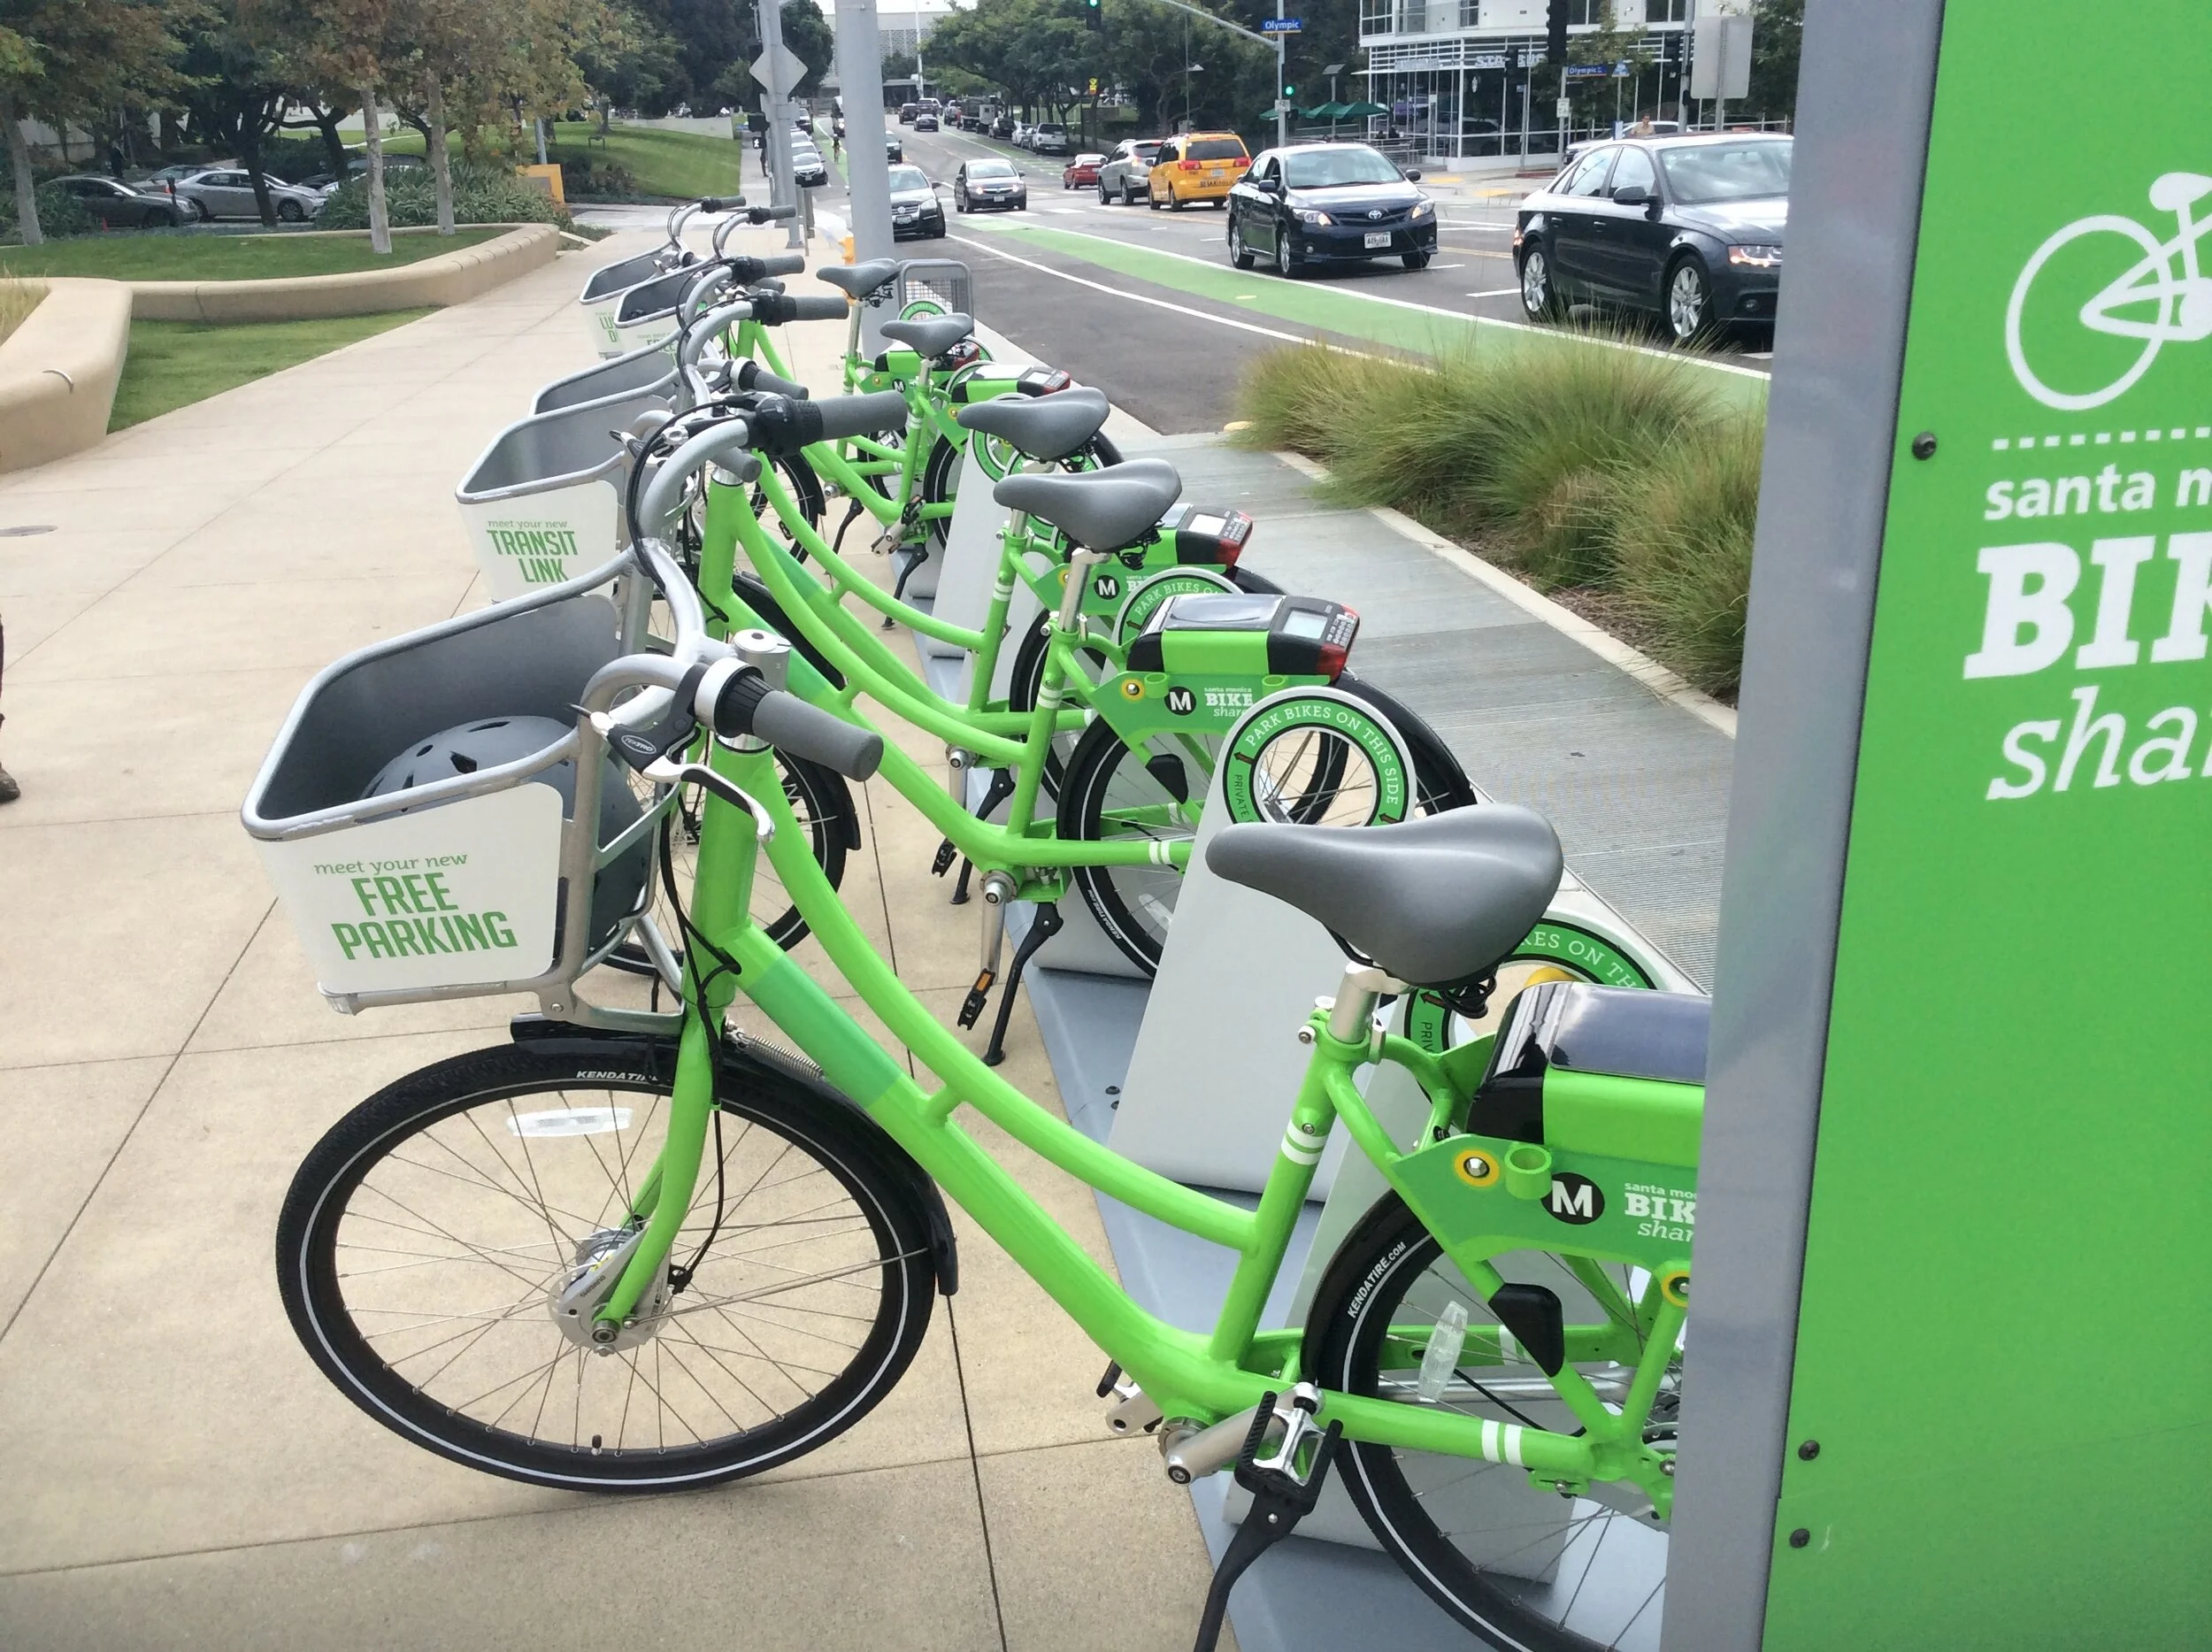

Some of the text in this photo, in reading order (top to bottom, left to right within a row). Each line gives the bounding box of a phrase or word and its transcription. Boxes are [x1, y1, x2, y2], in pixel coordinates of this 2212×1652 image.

[1265, 20, 1300, 31] Olympic
[1983, 463, 2156, 521] santa
[488, 519, 514, 528] meet
[517, 520, 543, 530] your
[487, 529, 578, 556] TRANSIT
[518, 558, 570, 582] LINK
[1098, 579, 1116, 595] M
[1134, 588, 1162, 616] PARK
[1164, 582, 1200, 593] BIKES
[1170, 691, 1193, 711] M
[1205, 693, 1253, 706] BIKE
[1245, 705, 1399, 804] PARK BIKES ON THIS SIDE
[1985, 685, 2212, 801] sha
[1233, 774, 1249, 818] PRIVATE
[313, 854, 468, 875] meet your new
[351, 872, 459, 917] FREE
[331, 911, 518, 960] PARKING
[1568, 941, 1605, 965] ON
[1607, 963, 1636, 988] TH
[1420, 1022, 1434, 1052] PRIV
[1552, 1180, 1593, 1218] M
[1624, 1182, 1665, 1195] santa
[1624, 1193, 1695, 1226] BIK
[1638, 1220, 1694, 1242] shar
[1348, 1241, 1406, 1318] KENDATIRE.COM
